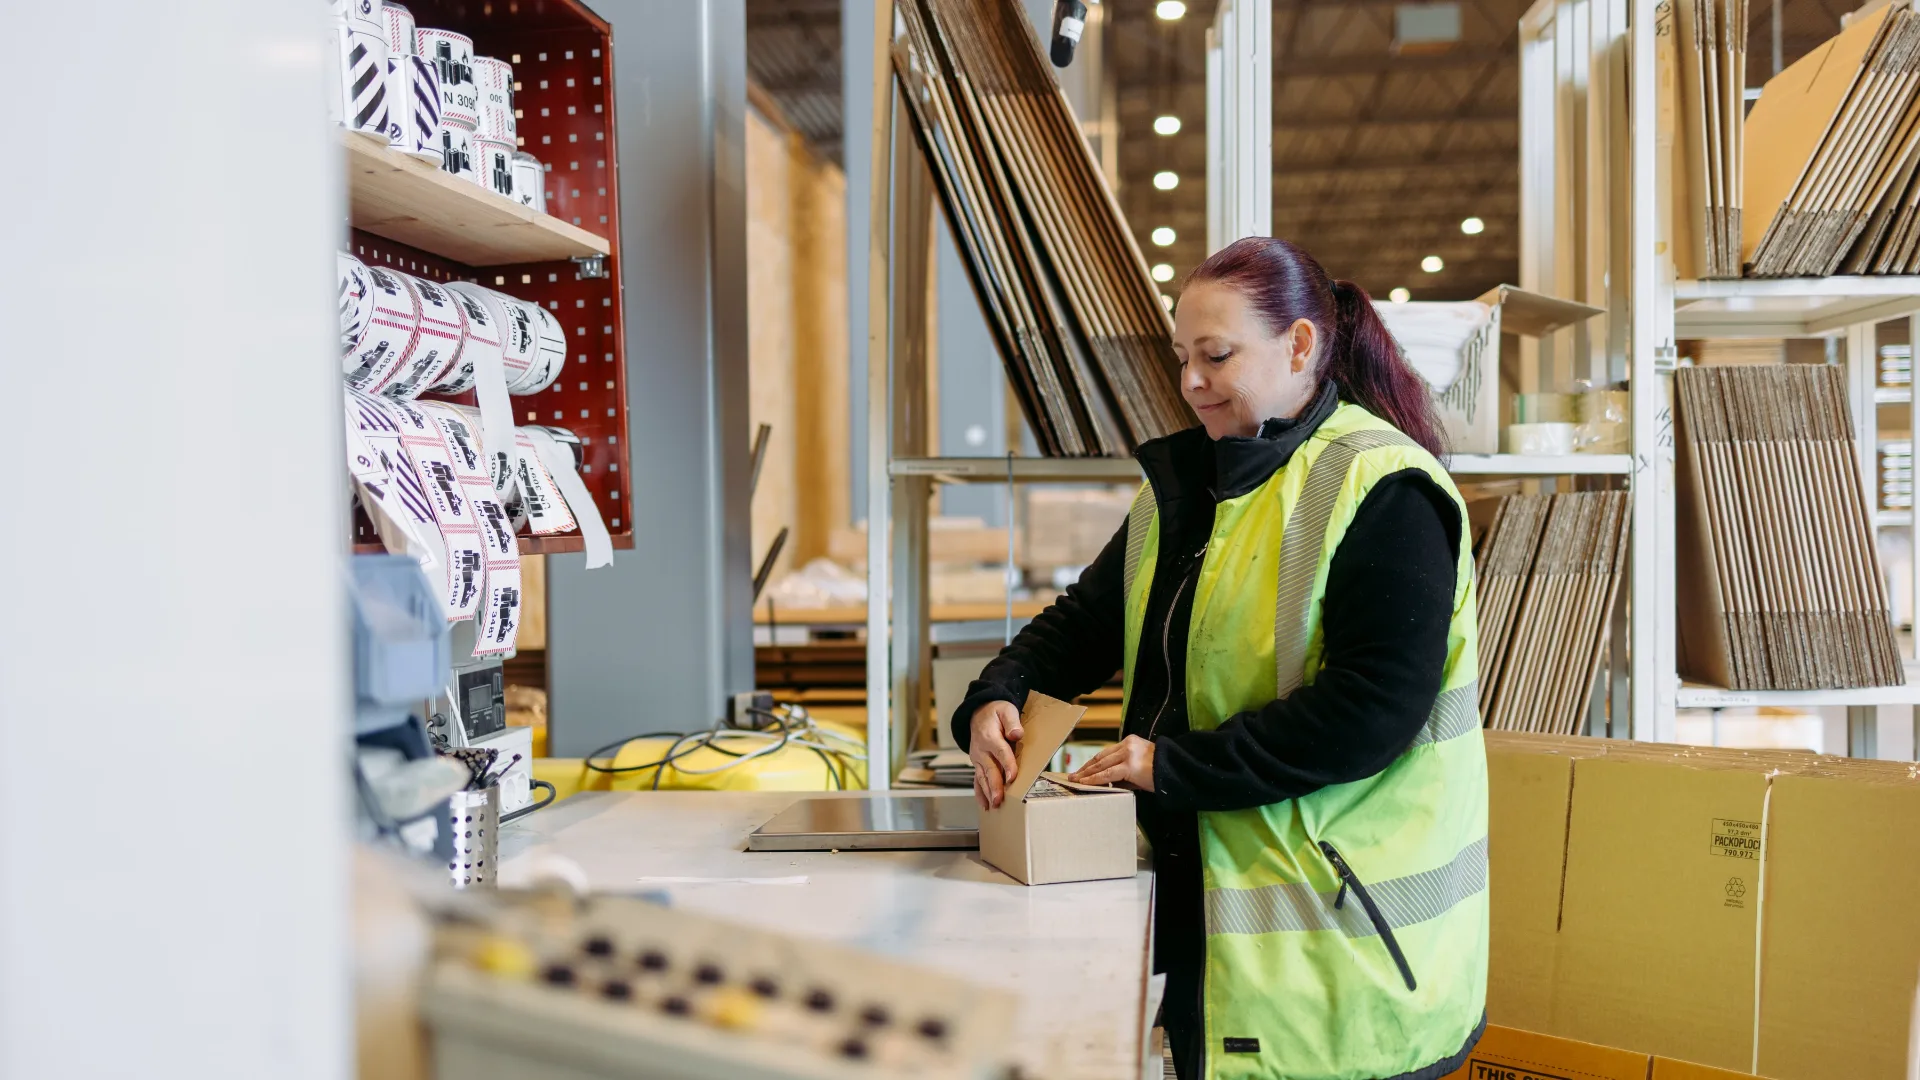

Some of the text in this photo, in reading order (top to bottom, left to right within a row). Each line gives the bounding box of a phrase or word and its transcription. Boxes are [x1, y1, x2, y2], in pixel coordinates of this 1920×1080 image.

[444, 91, 454, 105] N
[374, 350, 396, 376] 3480
[421, 460, 446, 512] UN 3480
[474, 500, 496, 548] UN 3481
[450, 550, 460, 606] UN 3480
[486, 588, 500, 639] UN 3481
[1724, 848, 1753, 859] 790.972
[1477, 1066, 1517, 1080] THIS
